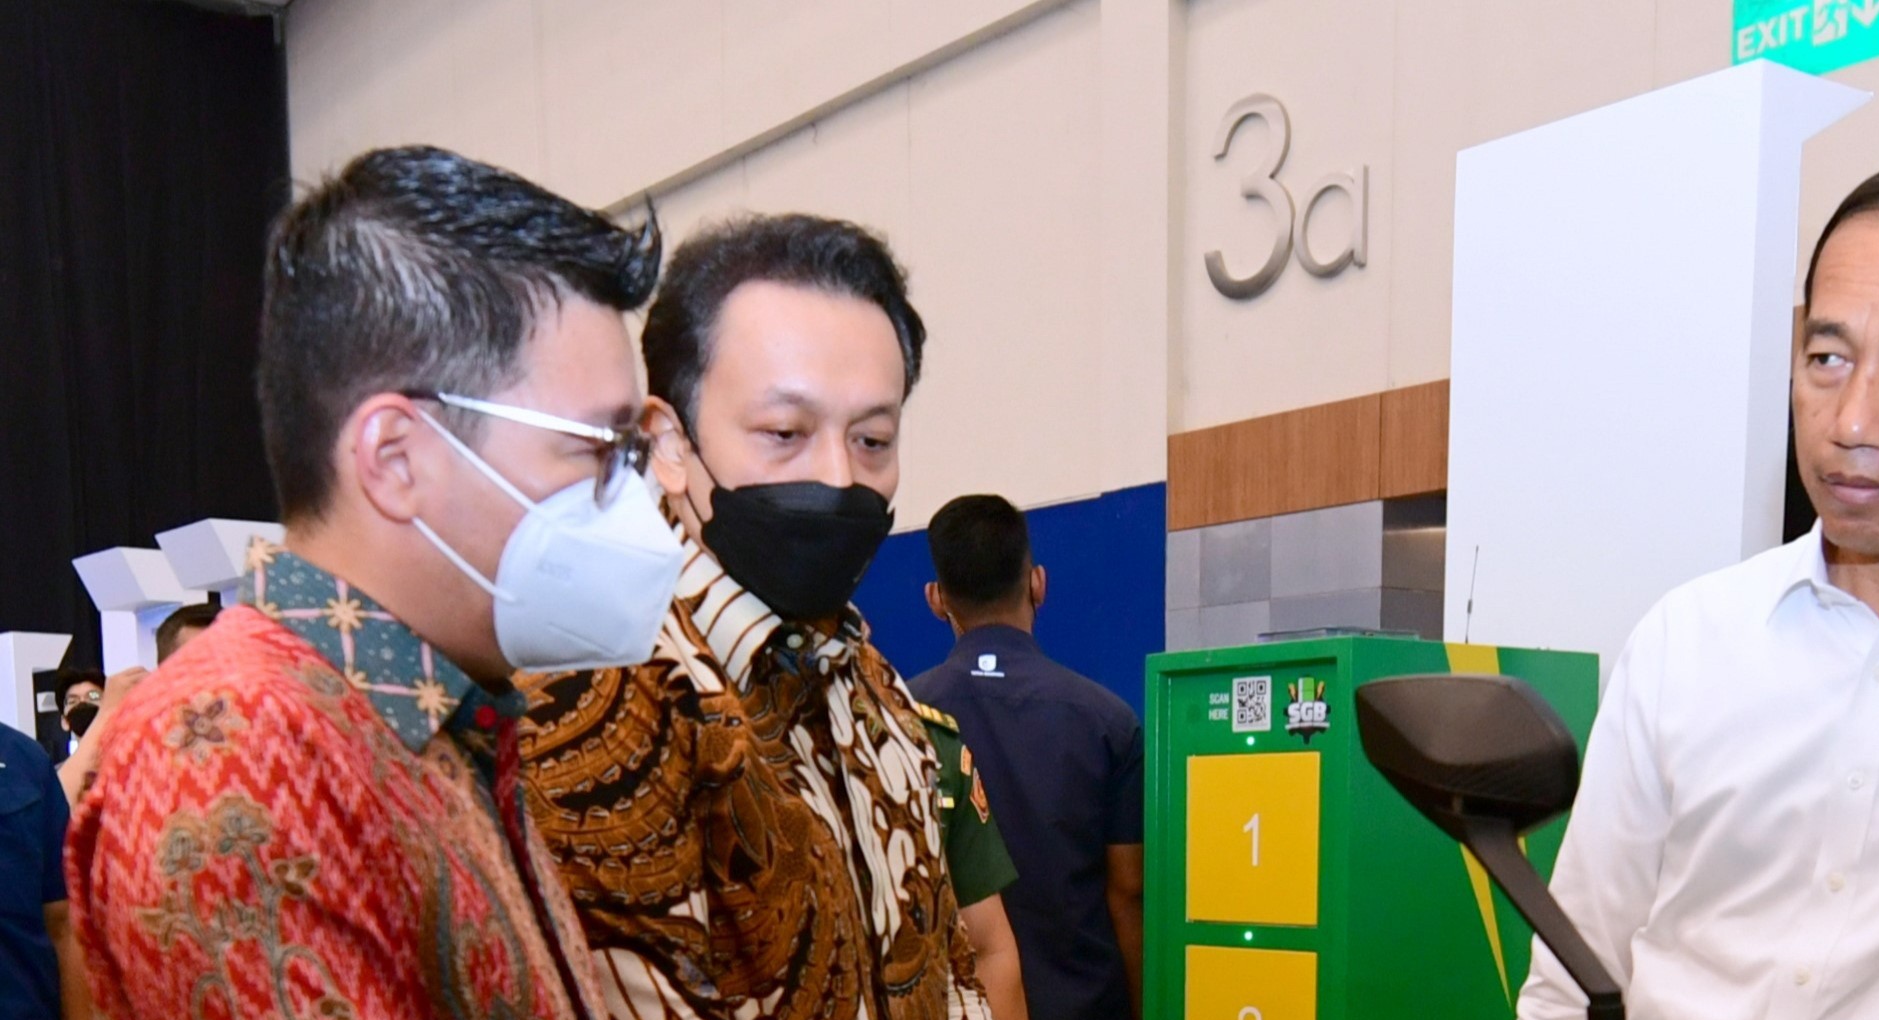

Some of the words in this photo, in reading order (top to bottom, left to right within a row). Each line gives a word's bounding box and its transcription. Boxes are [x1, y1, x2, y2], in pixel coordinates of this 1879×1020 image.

[1738, 5, 1809, 60] EXIT
[1204, 92, 1369, 301] 3a
[1208, 708, 1229, 721] HERE
[1209, 692, 1230, 705] SCAN
[1287, 701, 1328, 723] SGB
[1243, 812, 1261, 867] 1
